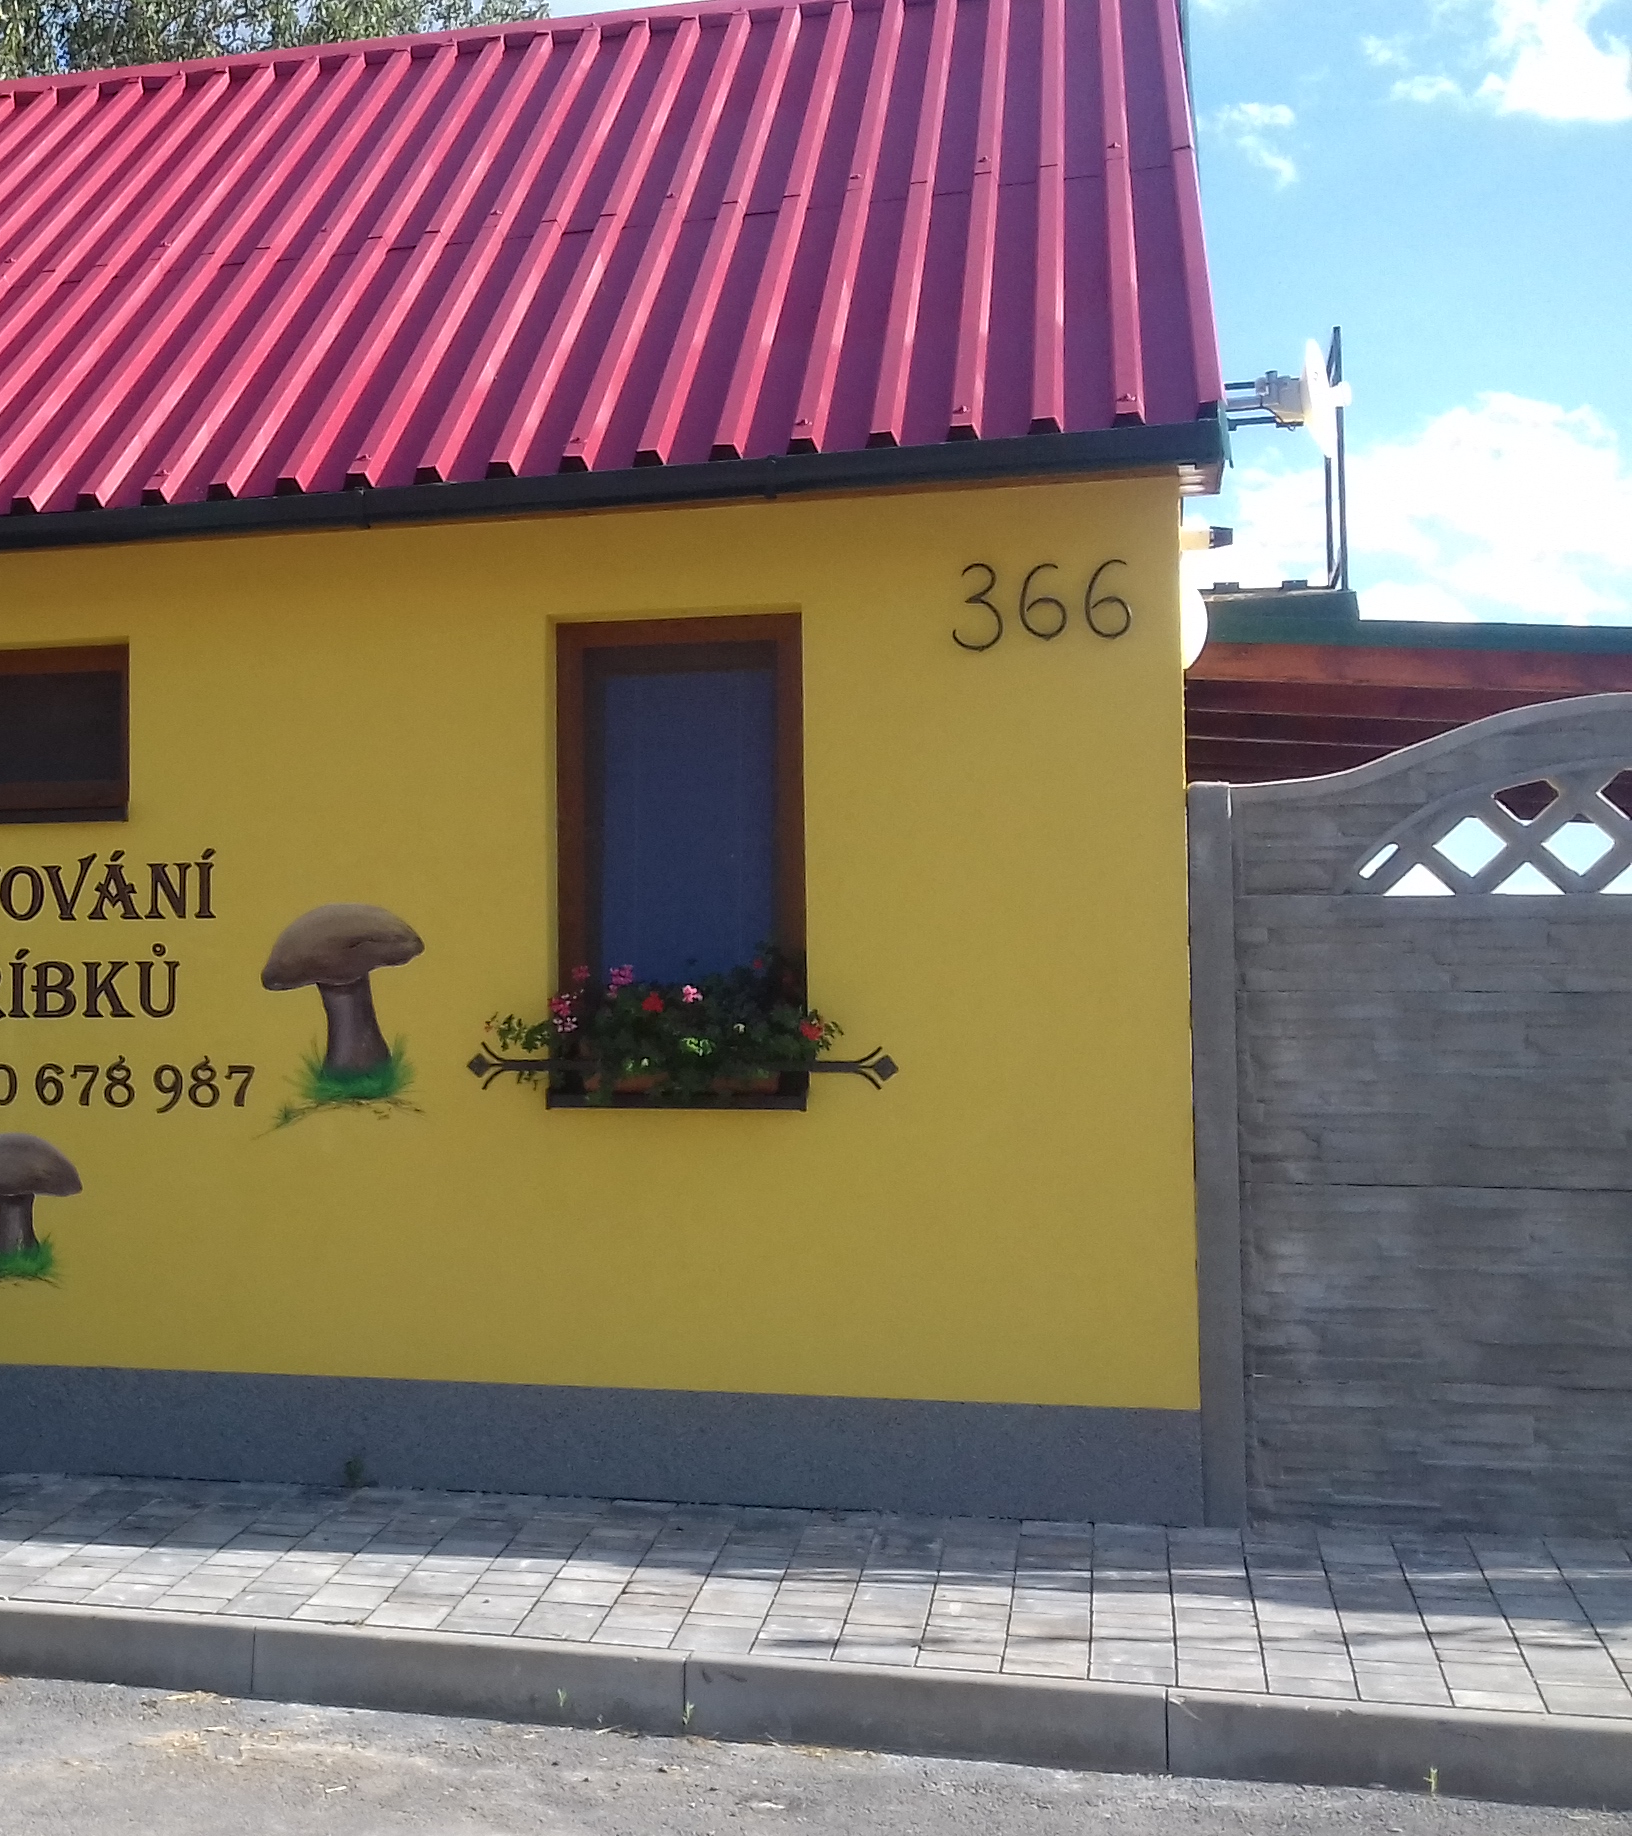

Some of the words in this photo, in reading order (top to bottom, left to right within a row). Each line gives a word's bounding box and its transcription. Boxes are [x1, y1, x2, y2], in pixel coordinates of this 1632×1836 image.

[951, 558, 1132, 653] 366
[34, 1054, 136, 1109] 678
[152, 1055, 256, 1114] 987
